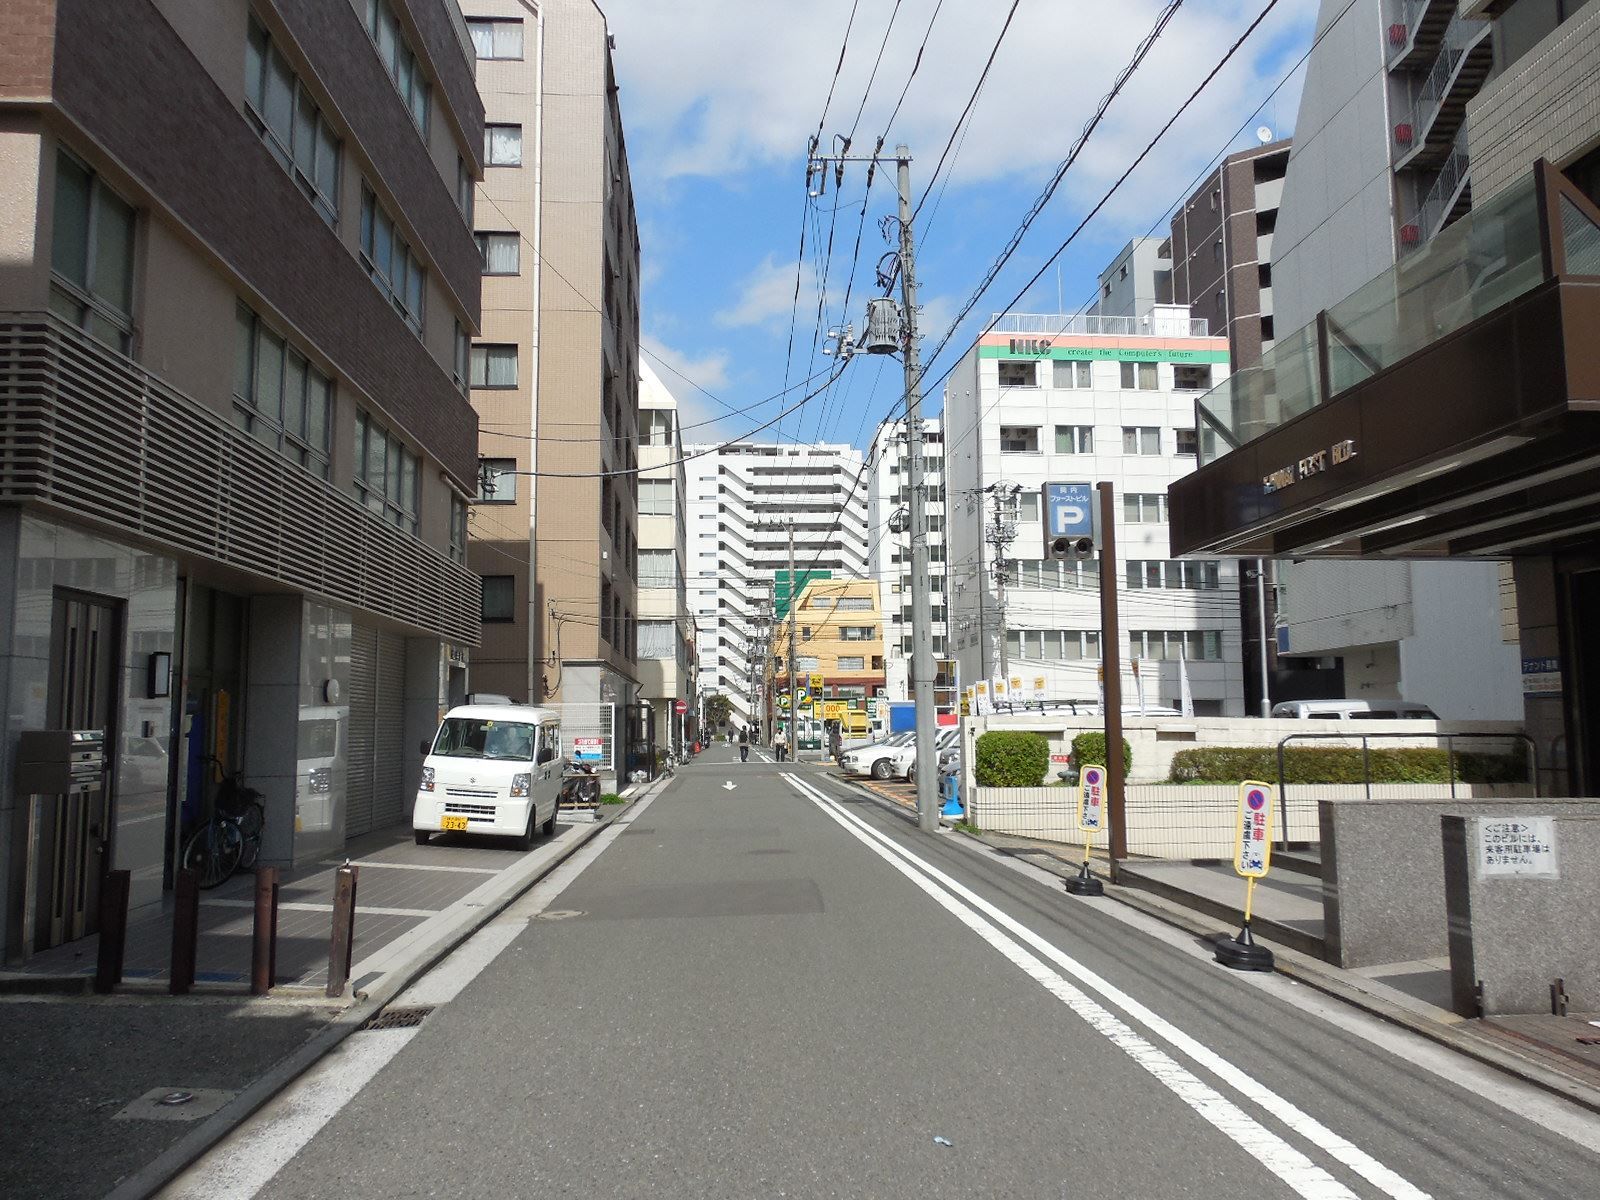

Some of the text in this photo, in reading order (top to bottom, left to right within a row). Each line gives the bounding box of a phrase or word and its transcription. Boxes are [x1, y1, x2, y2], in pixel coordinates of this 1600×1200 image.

[1067, 348, 1093, 356] create
[1168, 349, 1193, 358] future
[1298, 449, 1327, 480] FIRST
[1050, 494, 1089, 503] ファーストビル
[1056, 505, 1085, 533] P
[1090, 785, 1100, 807] 駐車
[1241, 810, 1253, 869] ご遠慮下さい
[1252, 812, 1266, 842] 駐車
